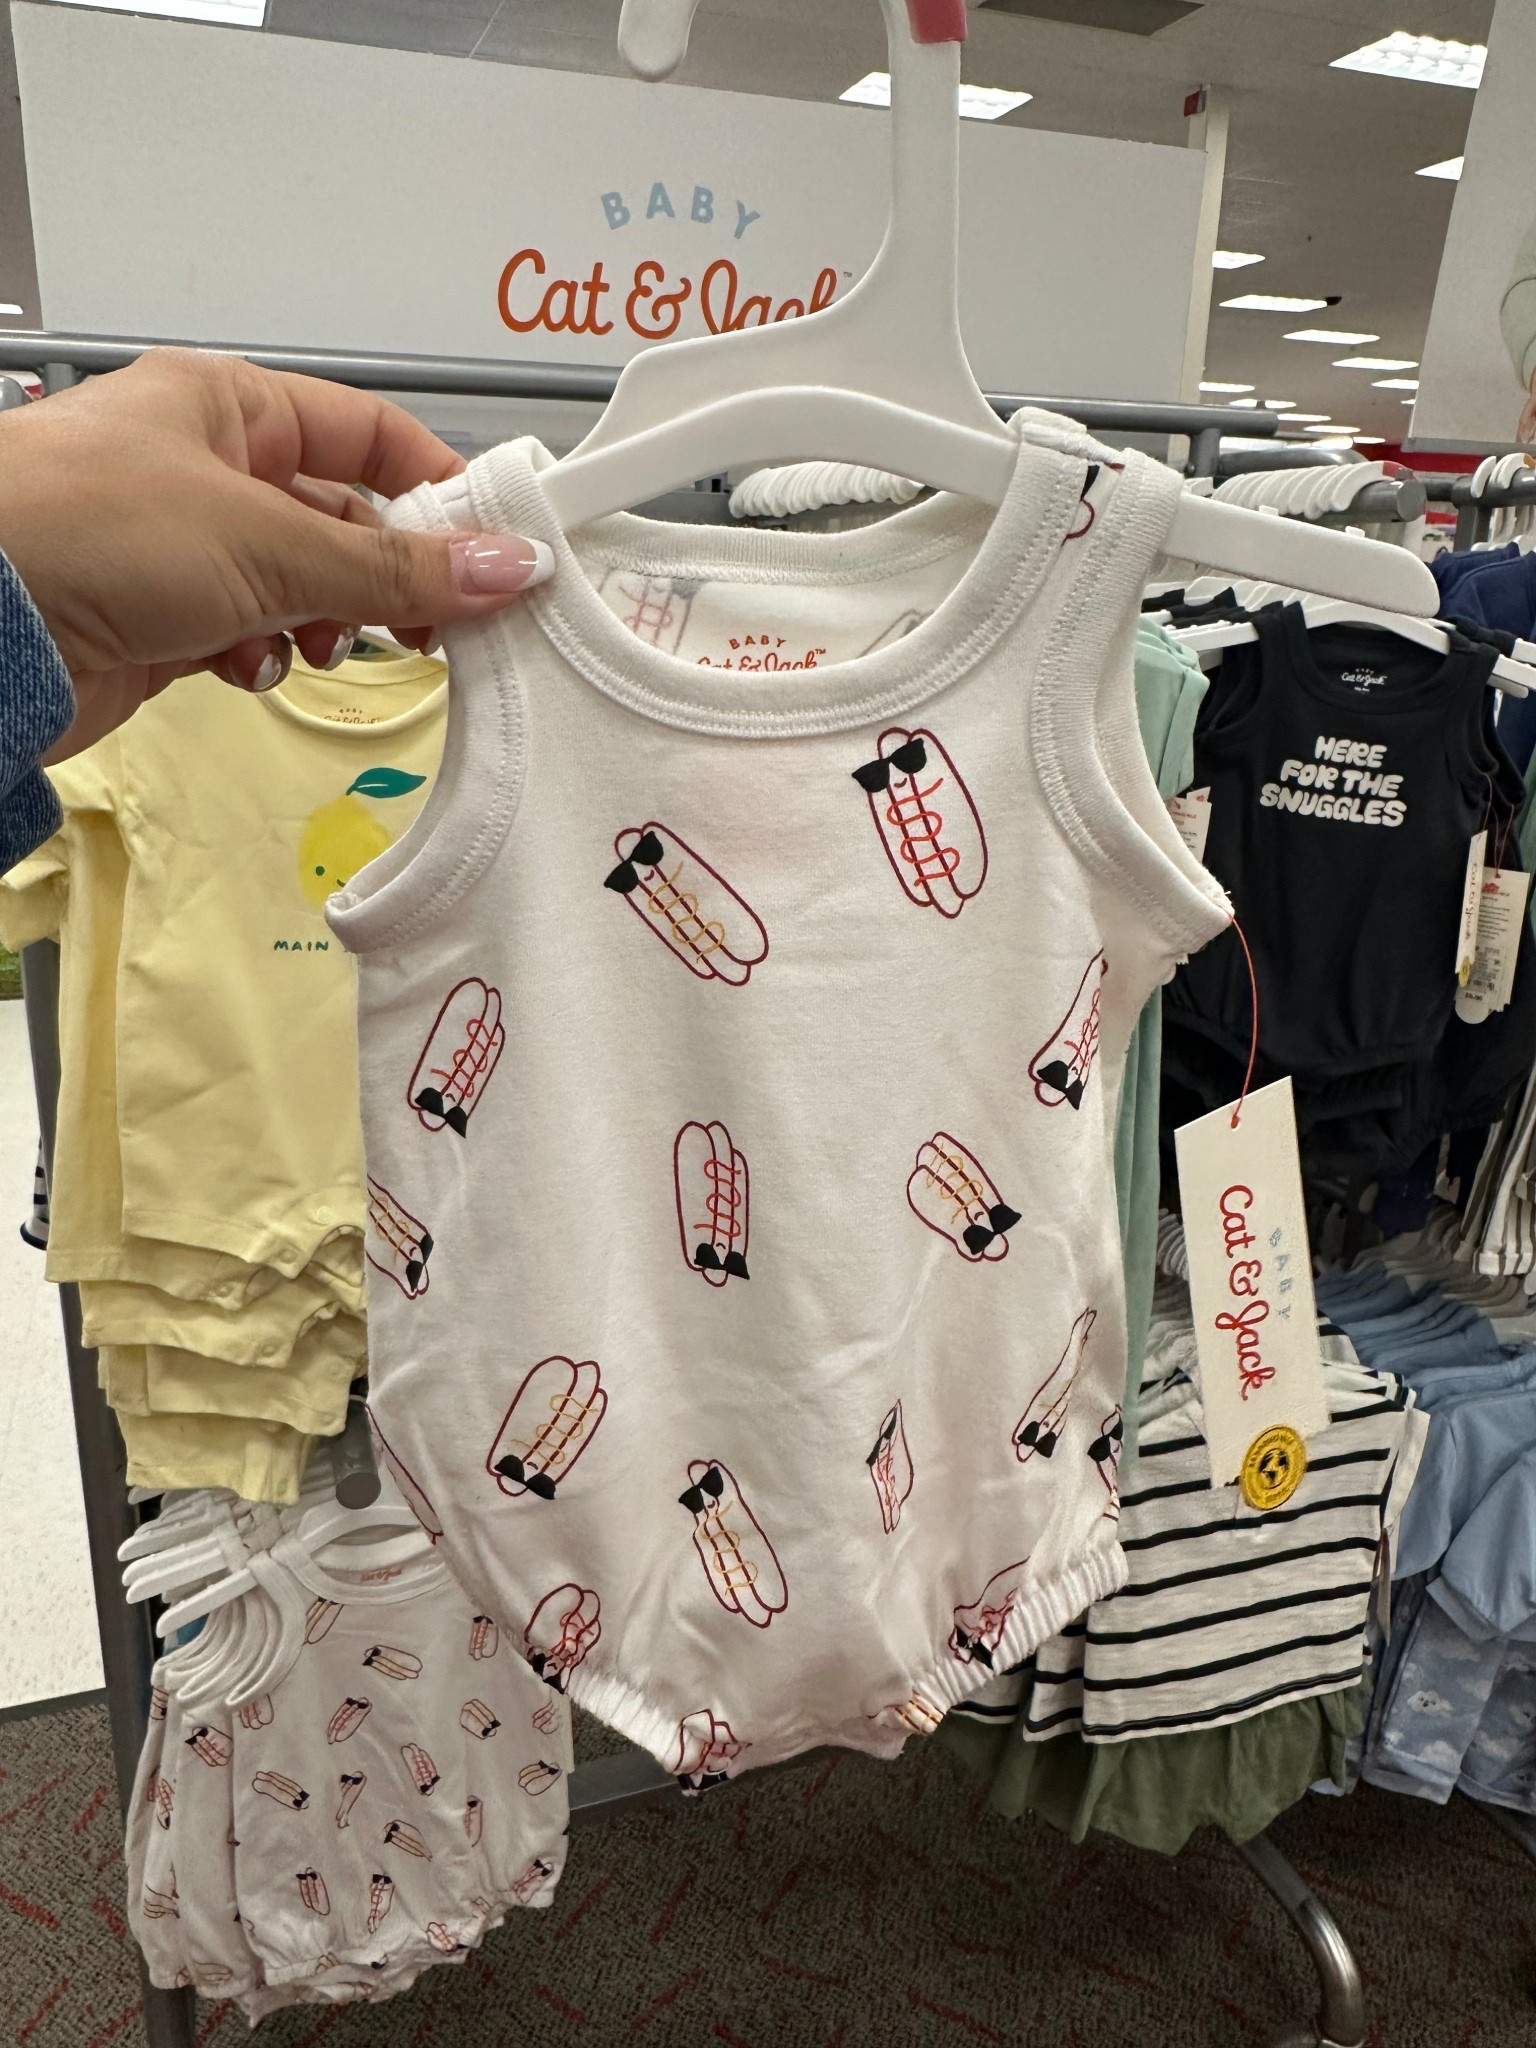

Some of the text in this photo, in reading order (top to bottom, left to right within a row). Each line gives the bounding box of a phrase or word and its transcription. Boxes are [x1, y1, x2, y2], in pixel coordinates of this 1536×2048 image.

[601, 182, 761, 239] BABY
[498, 248, 614, 336] Cat
[625, 260, 692, 340] &
[729, 635, 786, 650] BABY
[1314, 735, 1388, 768] HERE
[1280, 759, 1404, 799] FOR THE
[1259, 783, 1408, 827] SNUGGLES
[273, 939, 330, 952] MAIN
[1218, 1184, 1257, 1259] Cat
[1228, 1259, 1263, 1297] &
[1214, 1299, 1276, 1402] Jack
